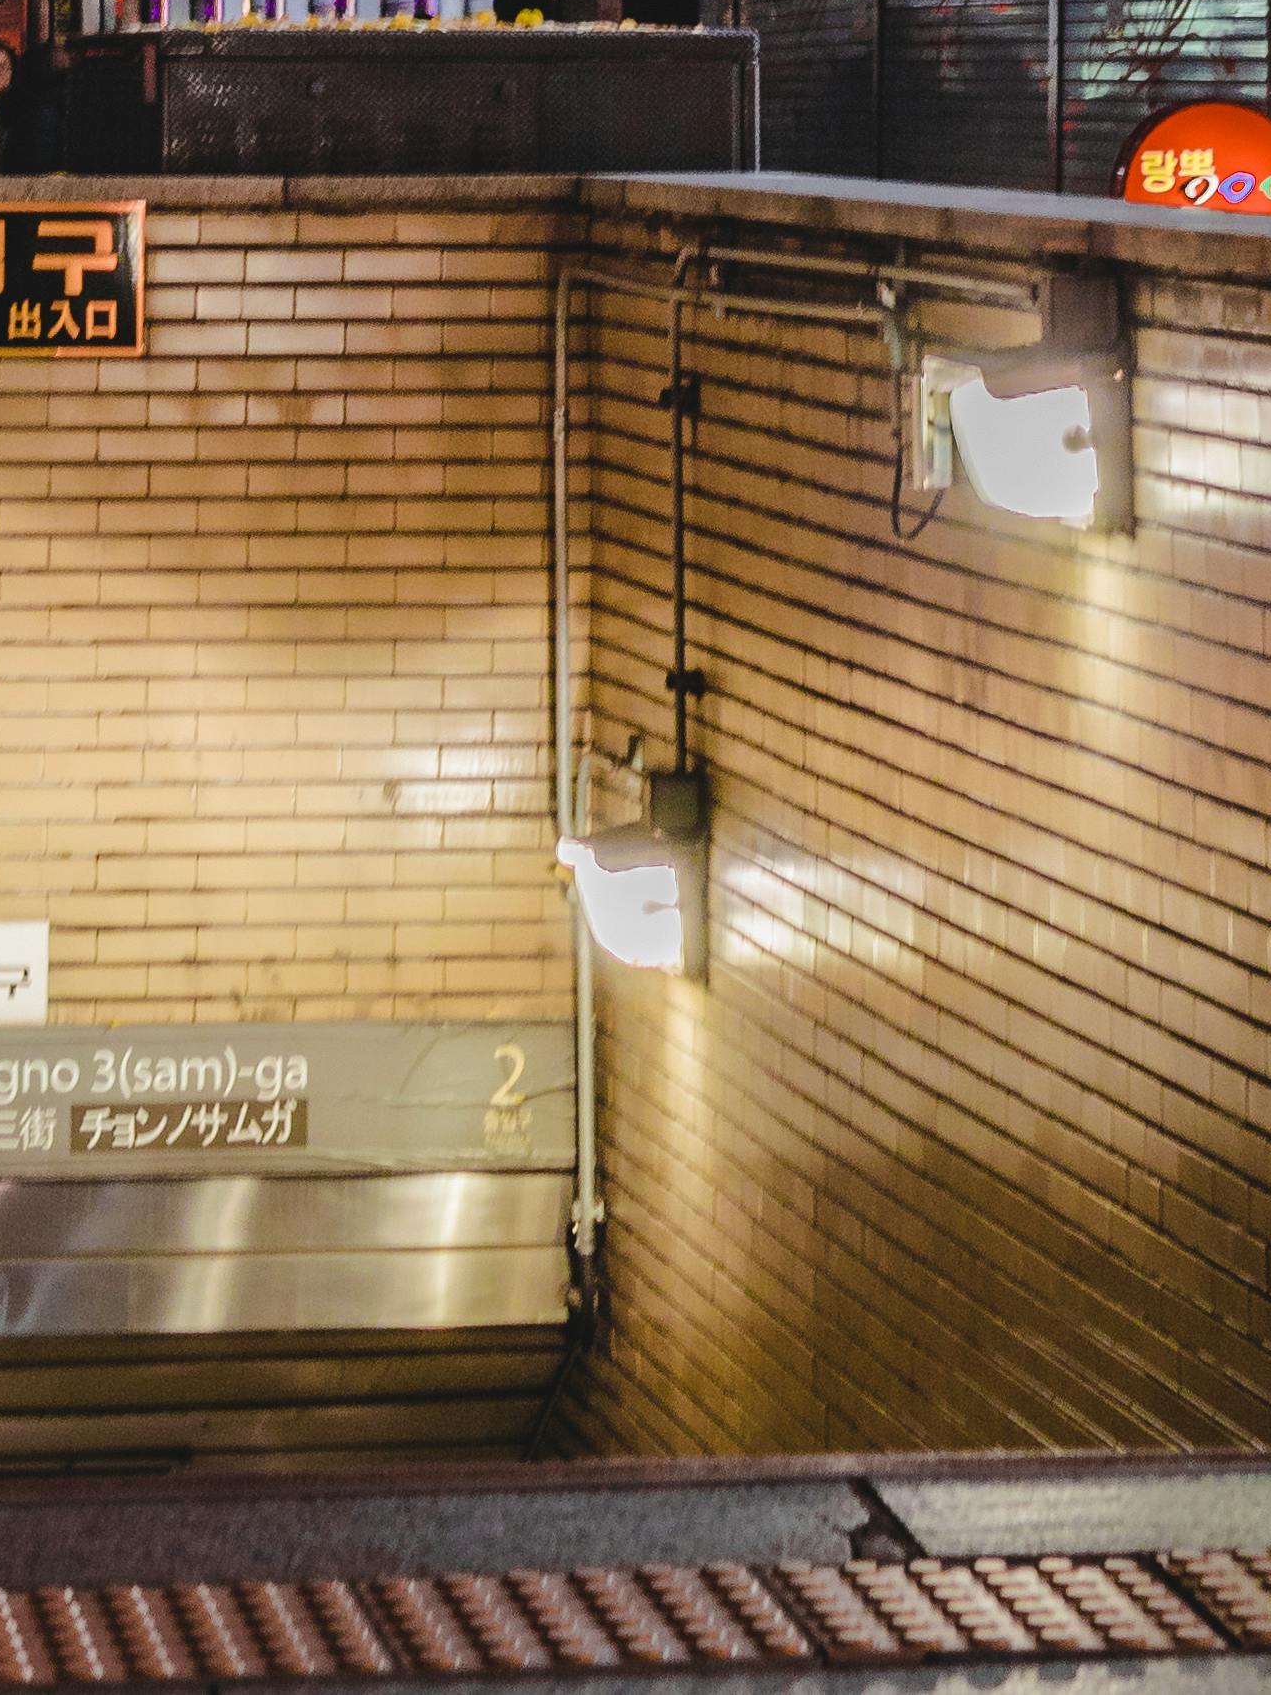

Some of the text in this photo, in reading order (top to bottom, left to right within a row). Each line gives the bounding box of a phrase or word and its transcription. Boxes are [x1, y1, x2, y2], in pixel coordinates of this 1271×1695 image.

[7, 298, 120, 342] 出入口
[90, 1047, 308, 1102] 3(sam)-ga
[492, 1044, 528, 1106] 2
[78, 1098, 297, 1152] チョンノサムガ
